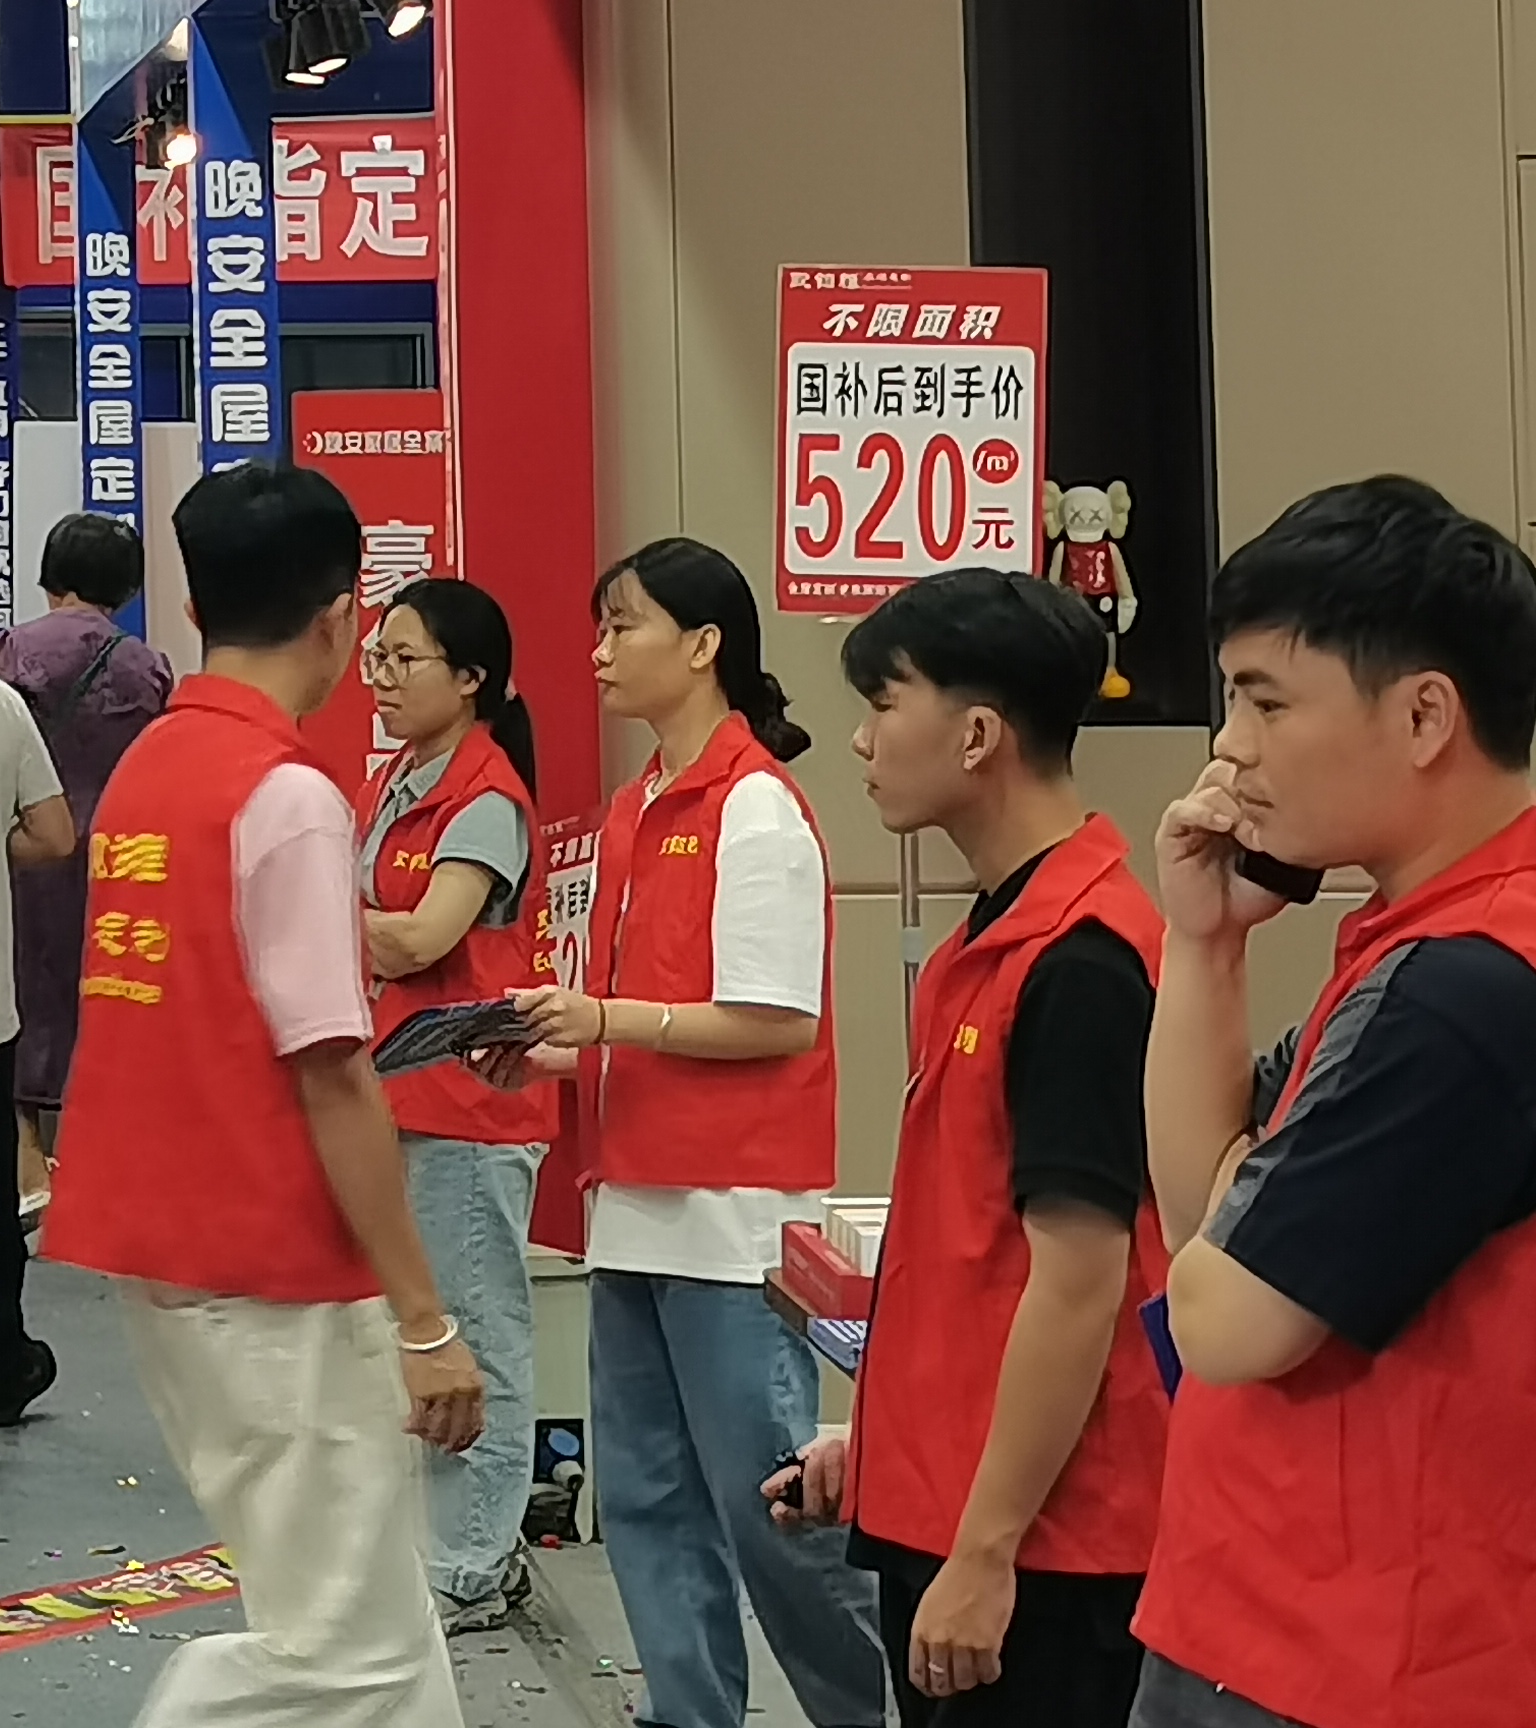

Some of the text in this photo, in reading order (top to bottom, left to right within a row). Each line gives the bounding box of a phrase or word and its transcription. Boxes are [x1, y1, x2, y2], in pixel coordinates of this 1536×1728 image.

[202, 158, 273, 472] 晚安全屋
[822, 302, 1002, 340] 不限面积
[85, 230, 137, 534] 晚安全屋定
[795, 361, 1024, 421] 国补后到手价
[794, 431, 967, 562] 520
[971, 507, 1016, 551] 元
